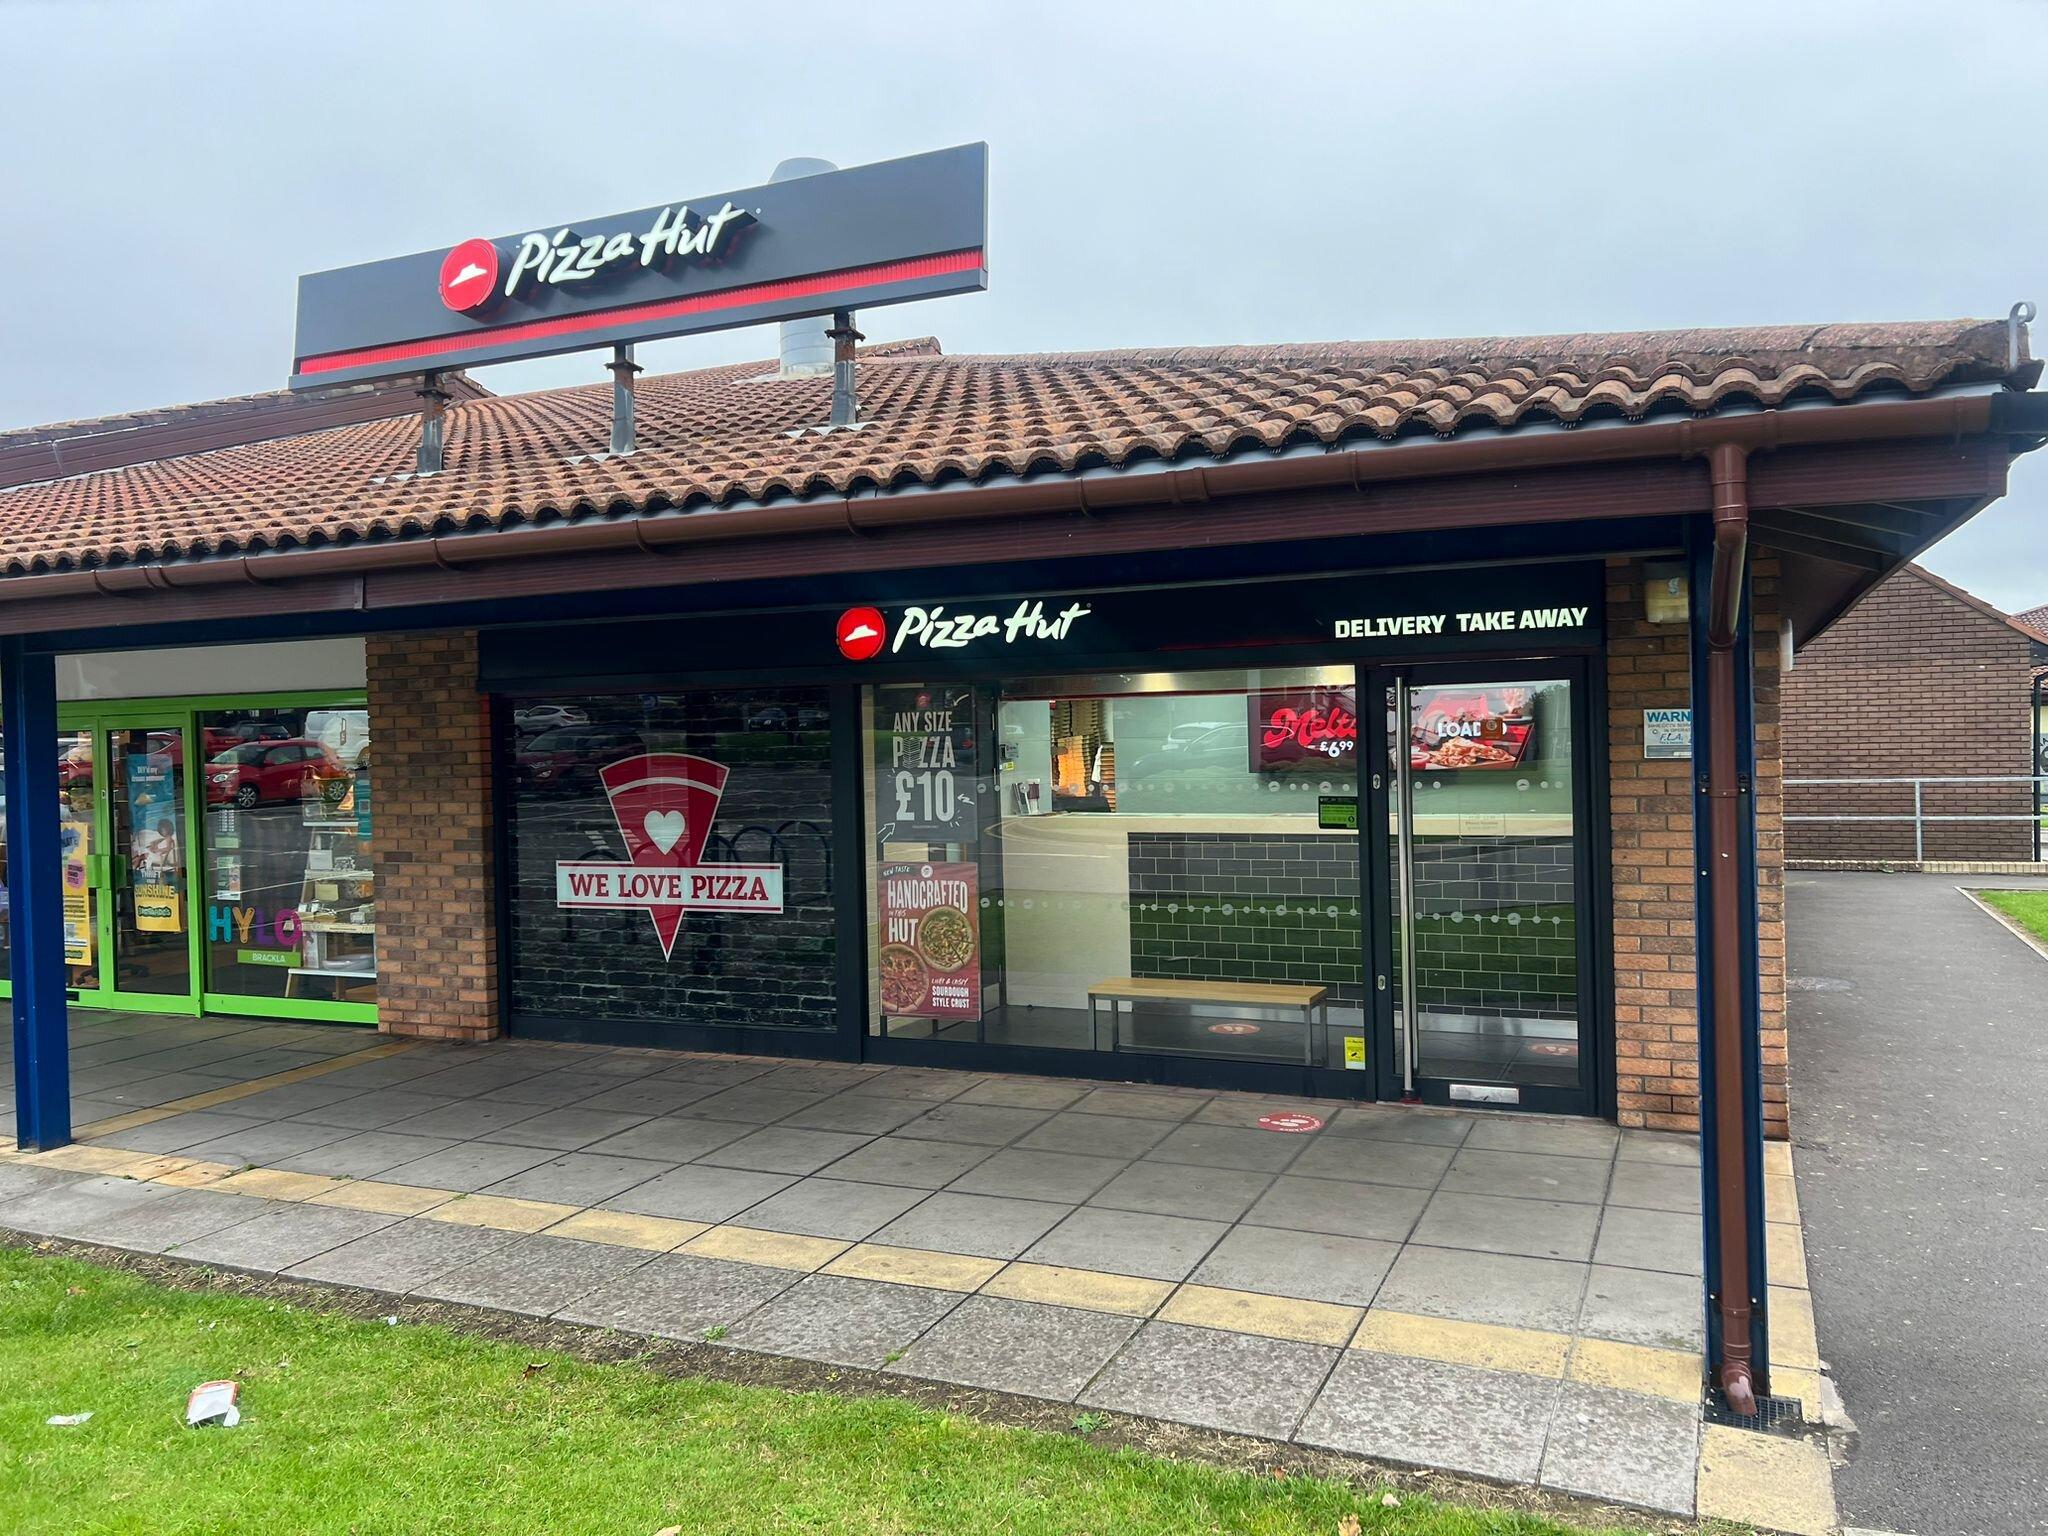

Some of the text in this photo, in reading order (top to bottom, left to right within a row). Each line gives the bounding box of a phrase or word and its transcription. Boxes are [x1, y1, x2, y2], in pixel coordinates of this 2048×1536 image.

[505, 202, 745, 297] Pizza Hut
[892, 600, 1091, 653] Pizza Hut
[1334, 607, 1588, 638] DELIVERY TAKE AWAY
[893, 711, 953, 732] ANY SIZE
[895, 770, 955, 822] £10
[569, 873, 769, 901] WE LOVE PIZZA
[888, 880, 968, 914] HANDCRAFTED
[888, 917, 919, 946] HUT
[252, 950, 286, 962] BRACKLA
[932, 997, 970, 1009] STYLE CRUST
